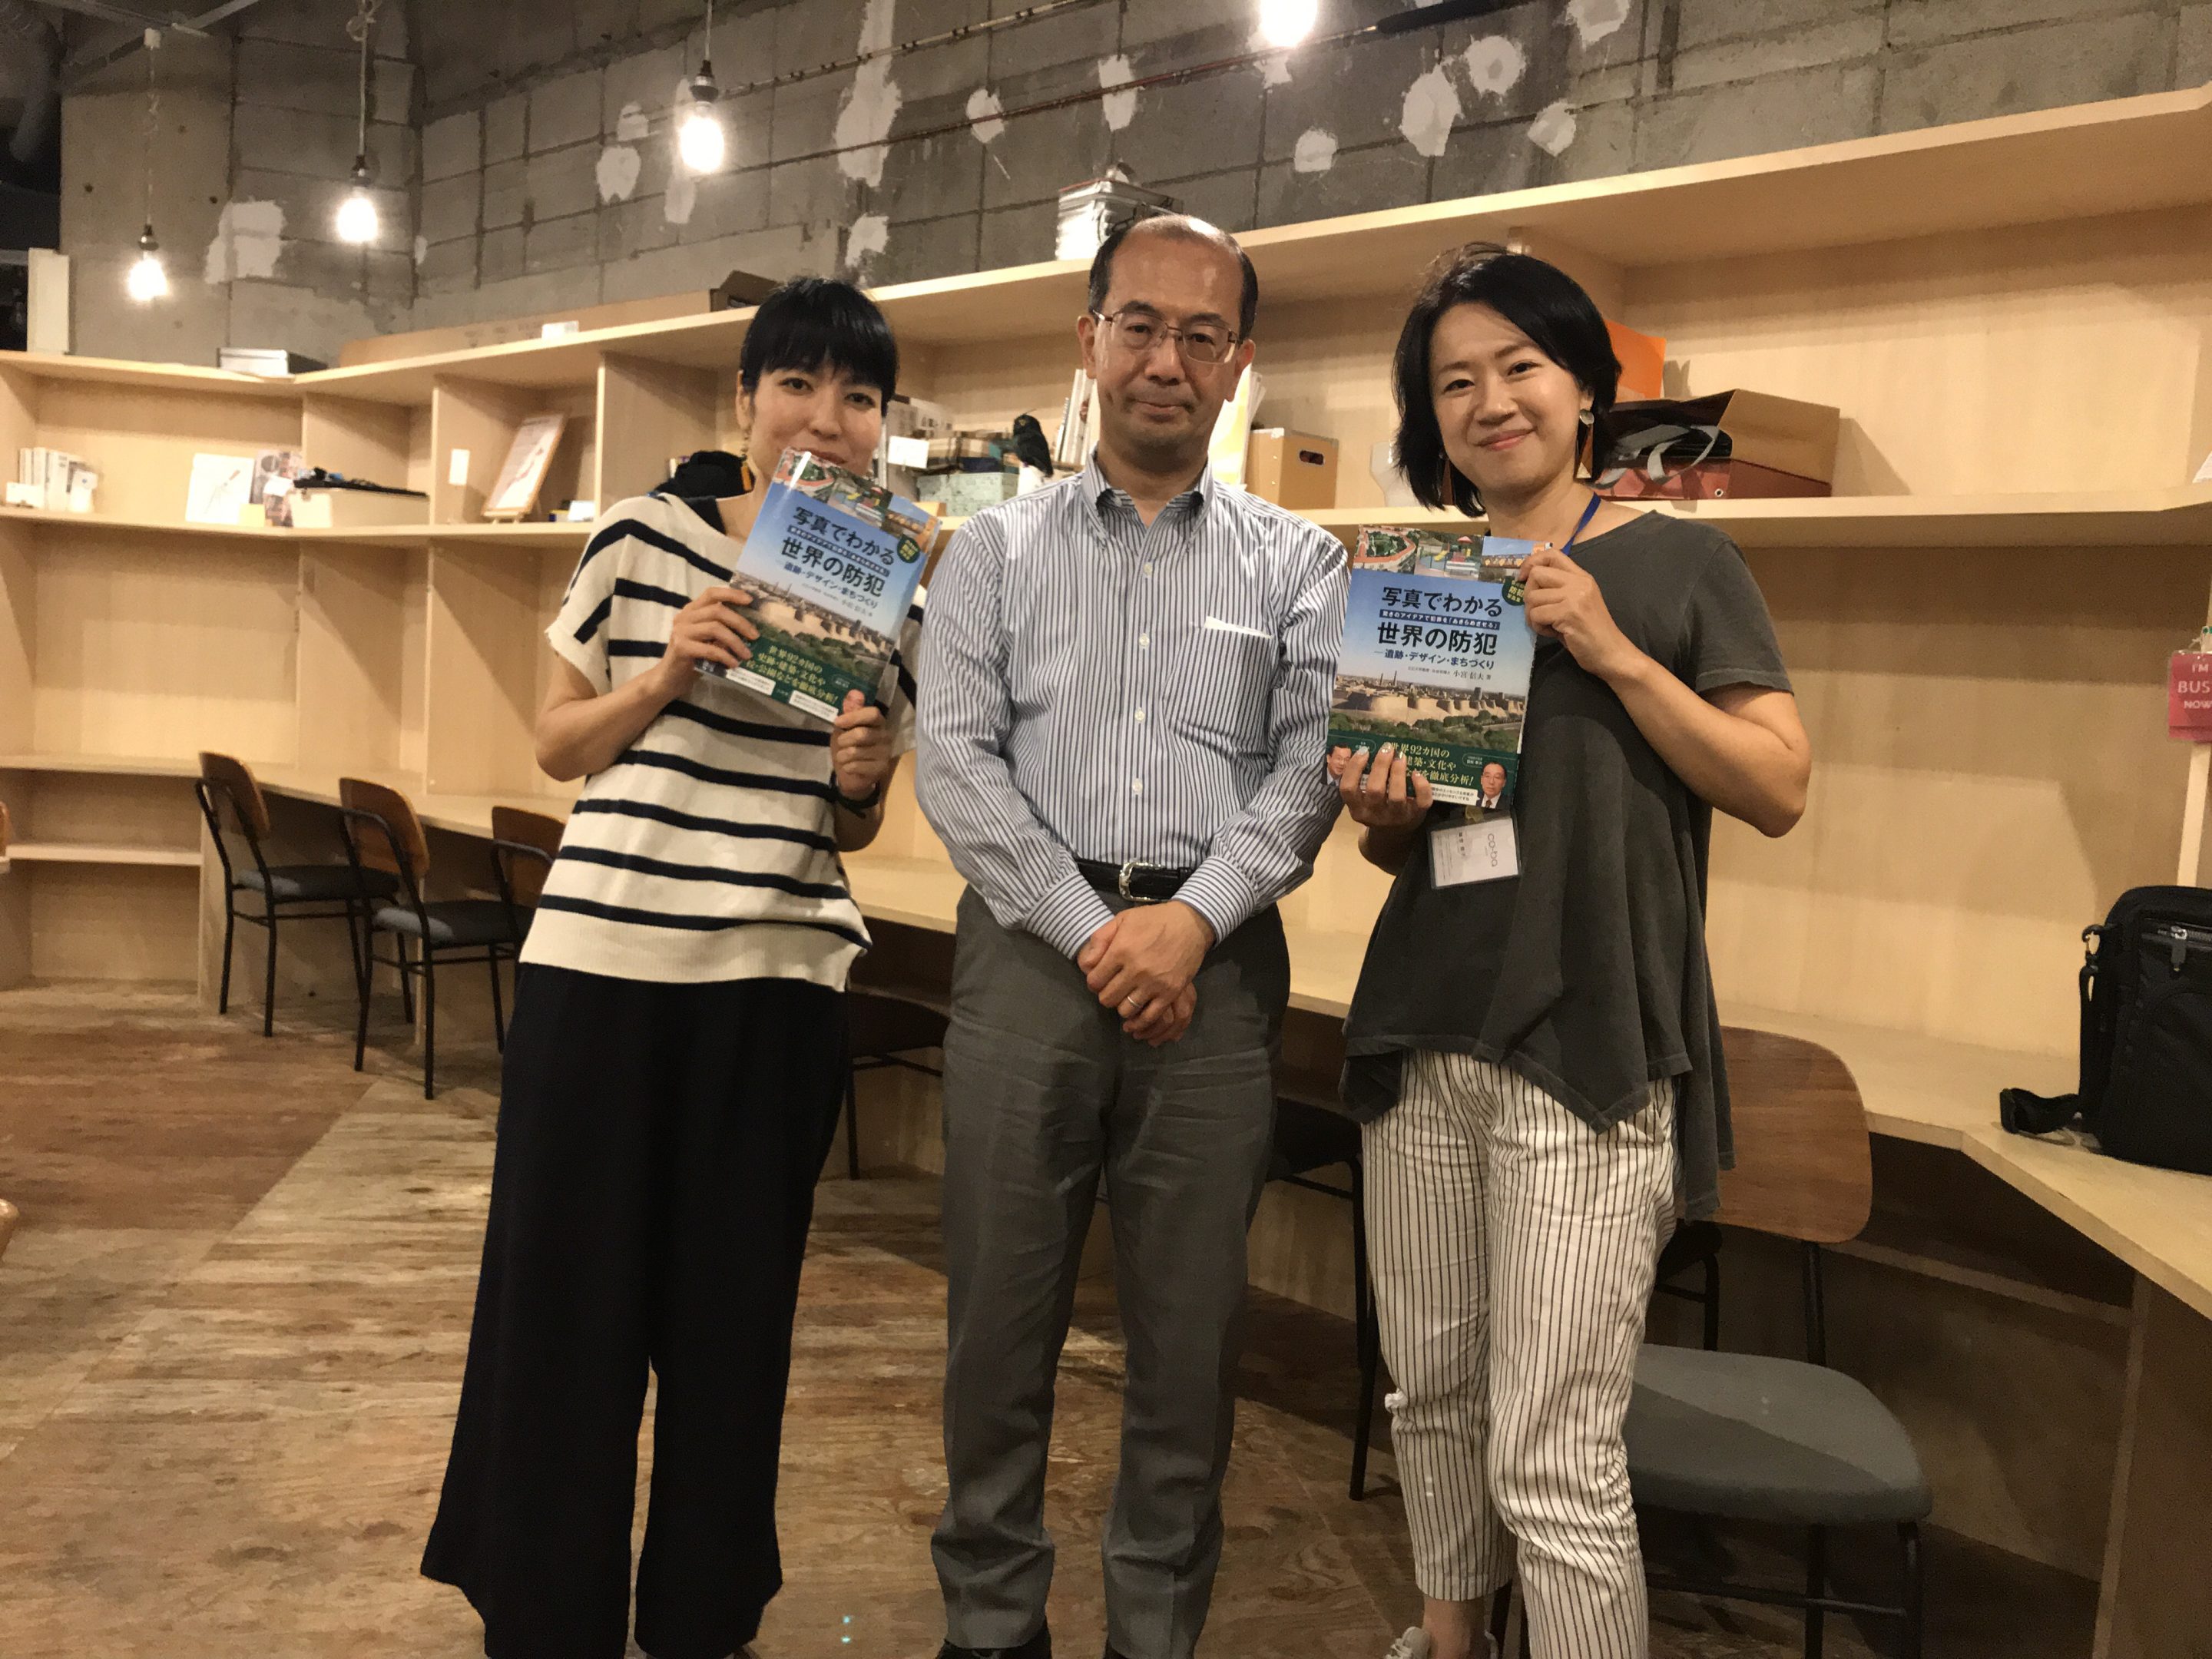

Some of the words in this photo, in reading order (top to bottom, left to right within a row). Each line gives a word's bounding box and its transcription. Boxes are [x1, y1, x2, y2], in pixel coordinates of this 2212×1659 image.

[793, 507, 894, 565] 写真でわかる
[781, 537, 886, 598] 世界の防犯
[1382, 586, 1502, 618] 写真でわかる
[1377, 621, 1498, 656] 世界の防犯
[2191, 664, 2209, 673] I'M
